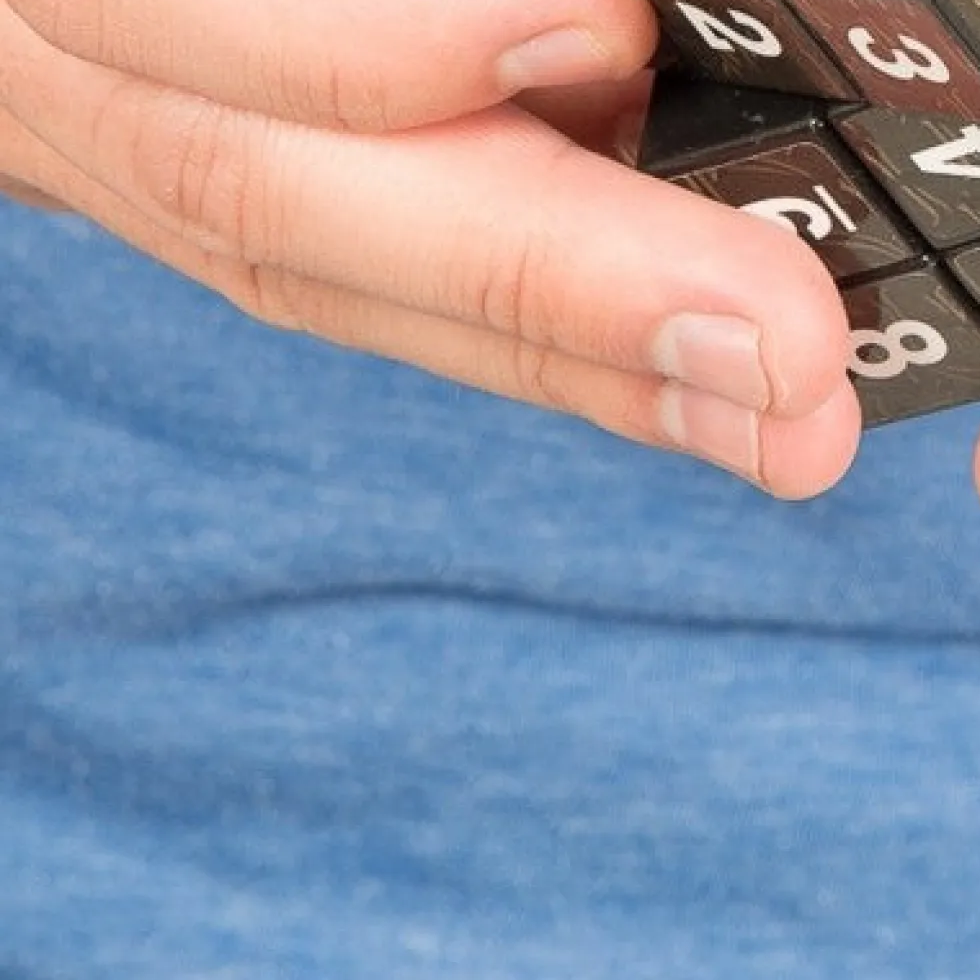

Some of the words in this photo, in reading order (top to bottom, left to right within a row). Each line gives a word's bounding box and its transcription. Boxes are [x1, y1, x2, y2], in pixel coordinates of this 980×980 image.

[675, 1, 783, 57] 2
[848, 27, 950, 83] 3
[848, 319, 948, 379] 8
